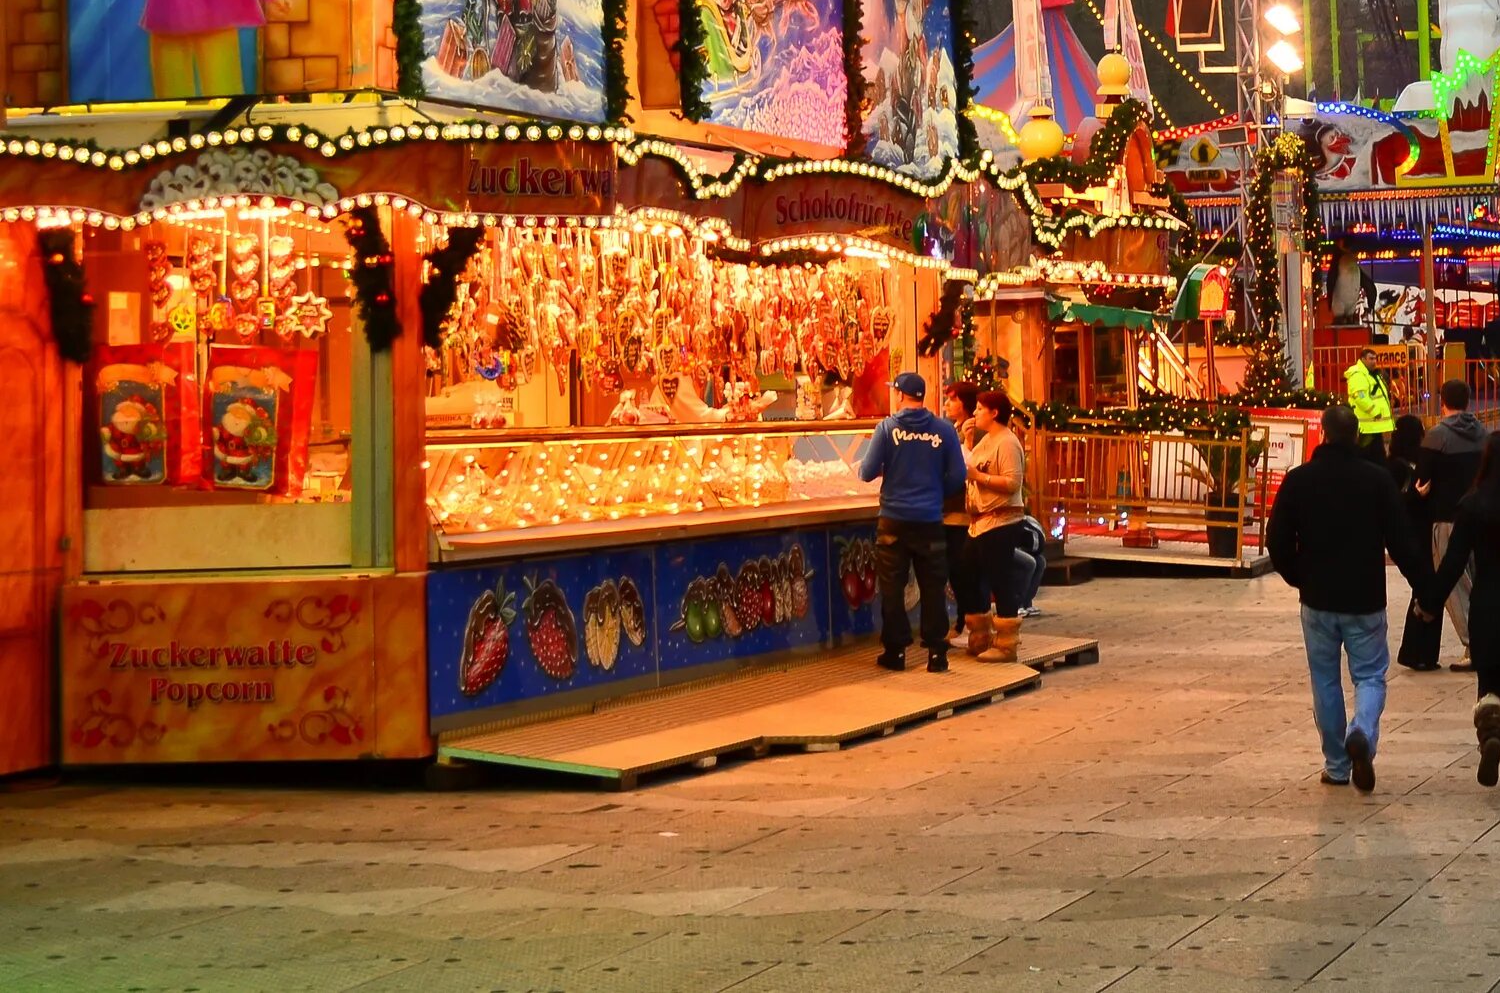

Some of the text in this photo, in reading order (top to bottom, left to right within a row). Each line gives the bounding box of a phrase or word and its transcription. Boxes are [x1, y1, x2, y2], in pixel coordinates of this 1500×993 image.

[775, 190, 914, 241] Schokofrüchte
[892, 428, 942, 448] Money
[109, 639, 316, 670] Zuckerwatte
[150, 677, 275, 709] Popcorn
